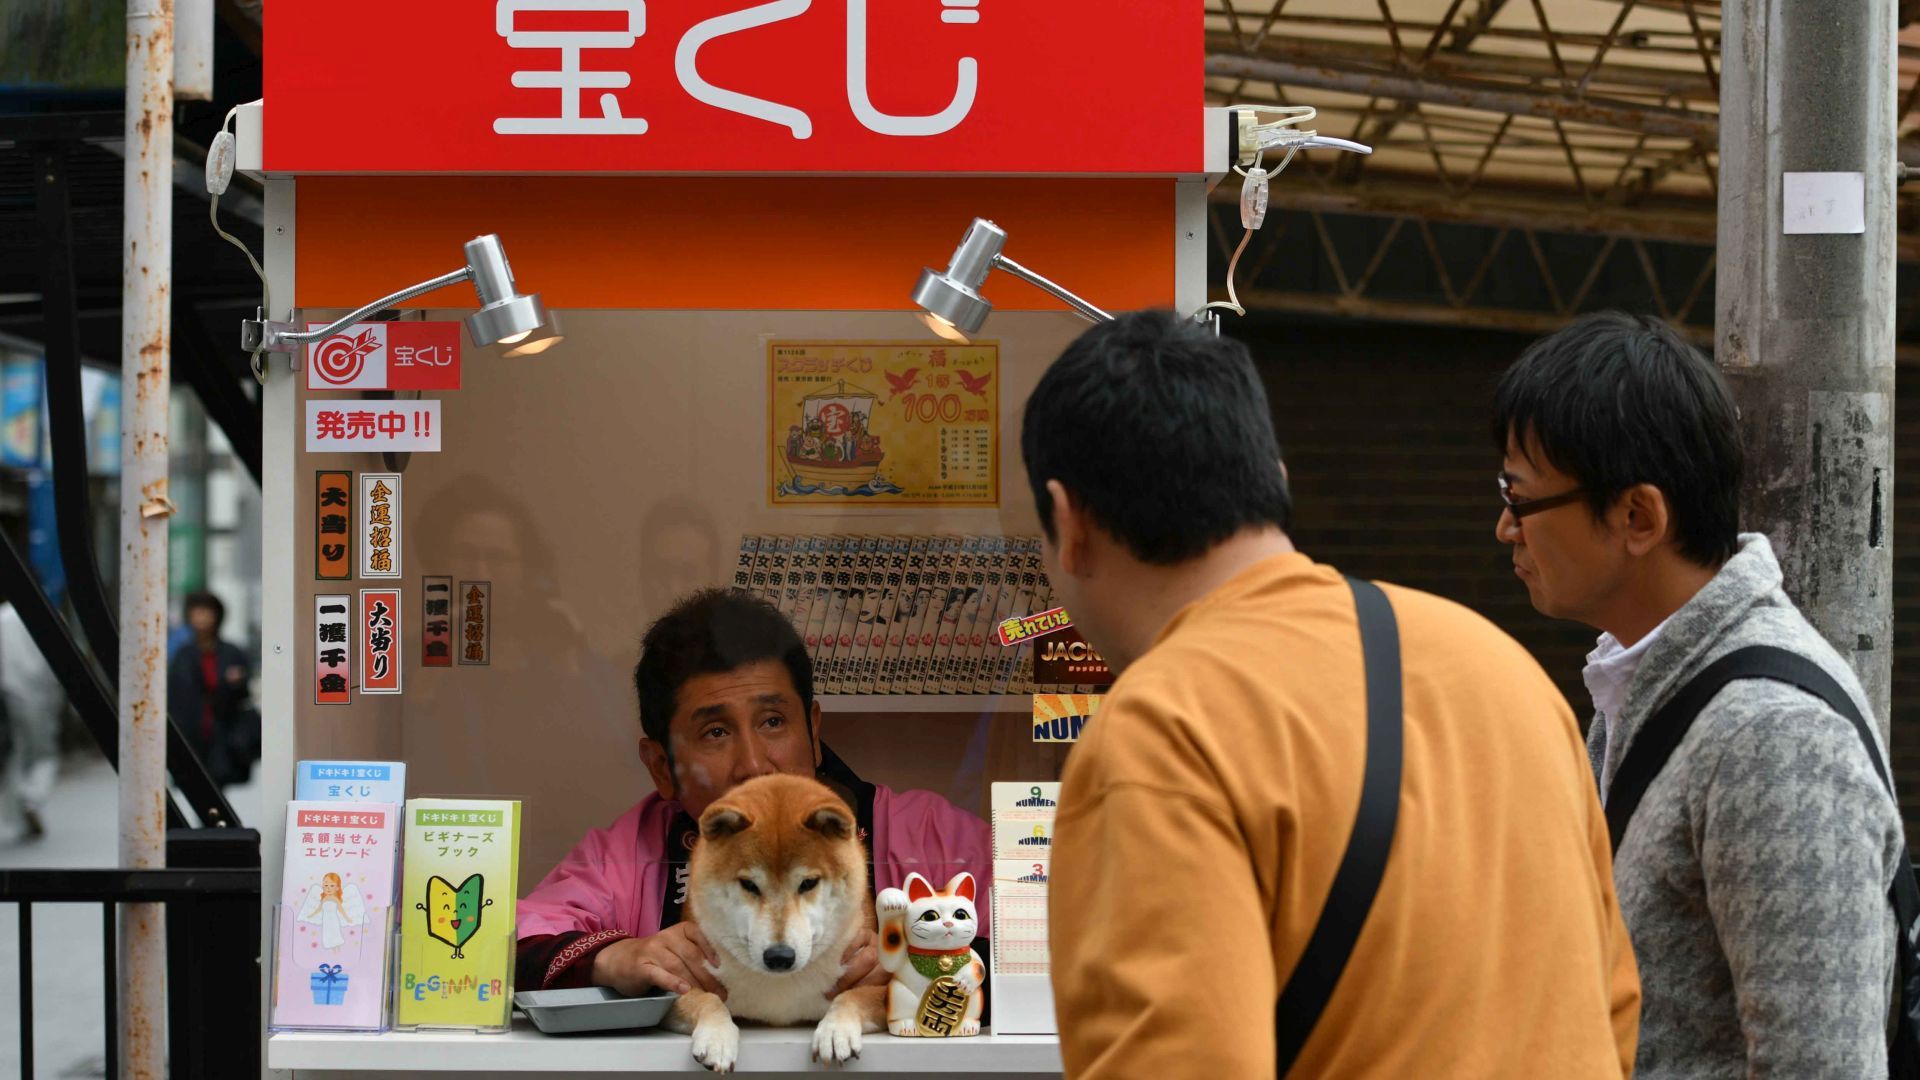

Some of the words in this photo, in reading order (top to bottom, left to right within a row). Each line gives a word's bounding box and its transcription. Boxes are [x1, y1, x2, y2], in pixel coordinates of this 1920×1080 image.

[492, 0, 980, 140] 宝くじ
[394, 345, 452, 367] 宝くじ
[320, 487, 348, 562] 大当り
[369, 480, 393, 572] 金運招福
[735, 553, 752, 586] 女帝
[752, 553, 770, 586] 女帝
[769, 553, 786, 586] 女帝
[787, 553, 805, 586] 女帝
[803, 553, 821, 586] 女帝
[820, 553, 838, 586] 女帝
[837, 553, 855, 586] 女帝
[854, 553, 871, 586] 女帝
[870, 553, 888, 586] 女帝
[886, 553, 905, 586] 女帝
[905, 553, 923, 586] 女帝
[921, 553, 939, 586] 女帝
[937, 553, 955, 586] 女帝
[954, 553, 973, 586] 女帝
[971, 553, 989, 586] 女帝
[987, 553, 1006, 586] 女帝
[1005, 553, 1023, 586] 女帝
[1021, 553, 1040, 586] 女帝
[319, 604, 347, 694] 一獲千金
[369, 601, 393, 680] 大当り
[317, 767, 382, 779] ドキドキ!宝くじ
[328, 785, 371, 797] 宝くじ
[1030, 786, 1042, 799] 9
[304, 814, 378, 826] ドキドキ!宝くじ
[421, 812, 497, 824] ドキドキ!宝くじ
[1032, 825, 1045, 838] 6
[301, 831, 378, 846] 高額当せん
[305, 847, 370, 859] エピソード
[423, 831, 495, 843] ビギナーズ
[438, 846, 479, 858] ブック
[1032, 863, 1044, 876] 3
[405, 972, 502, 1002] BEGINNER
